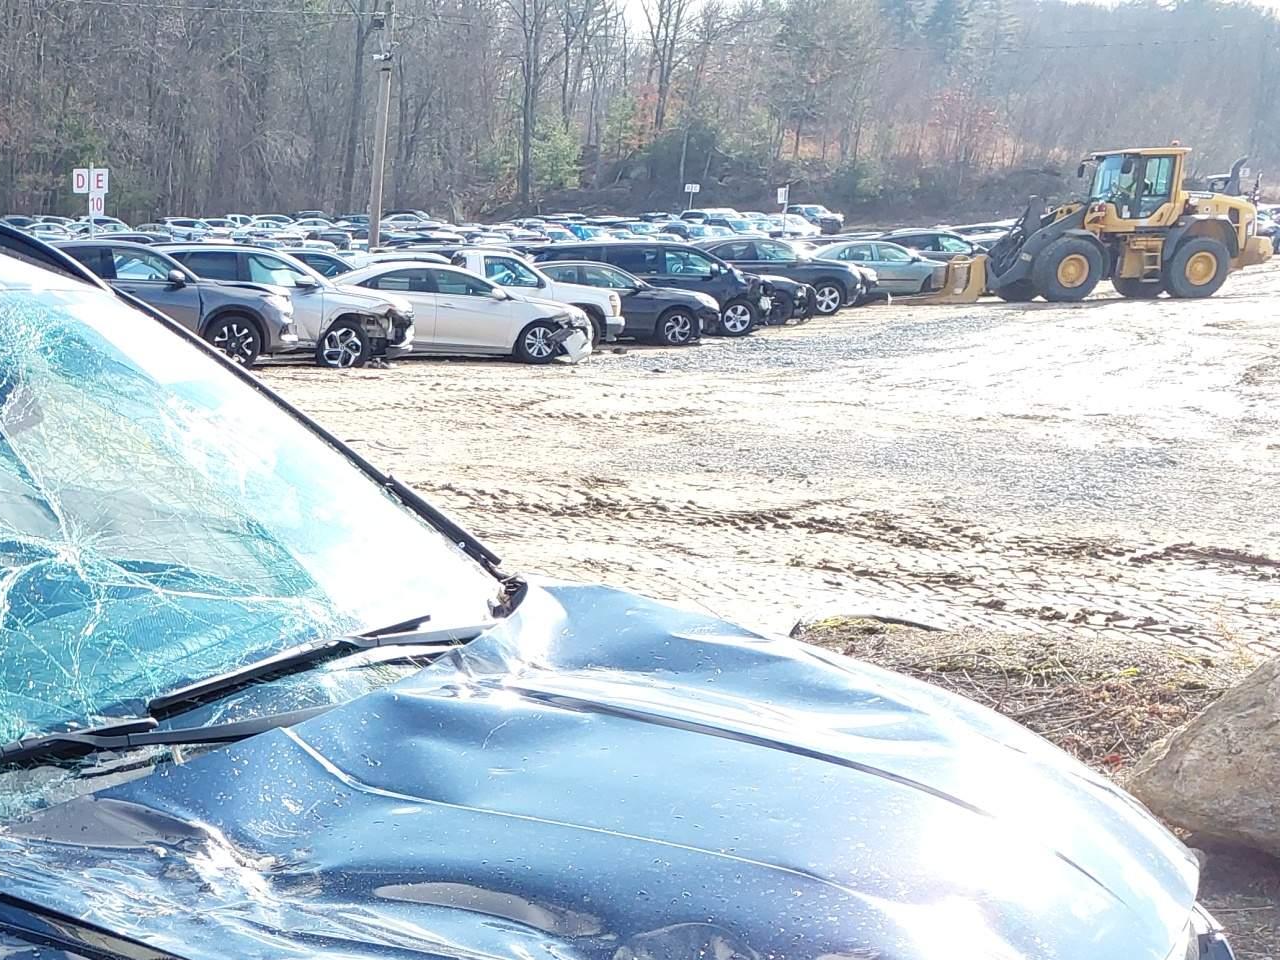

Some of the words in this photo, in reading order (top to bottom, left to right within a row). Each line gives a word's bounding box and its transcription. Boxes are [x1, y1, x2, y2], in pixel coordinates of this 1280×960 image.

[76, 173, 85, 189] D
[96, 173, 104, 189] E
[90, 197, 103, 212] 10
